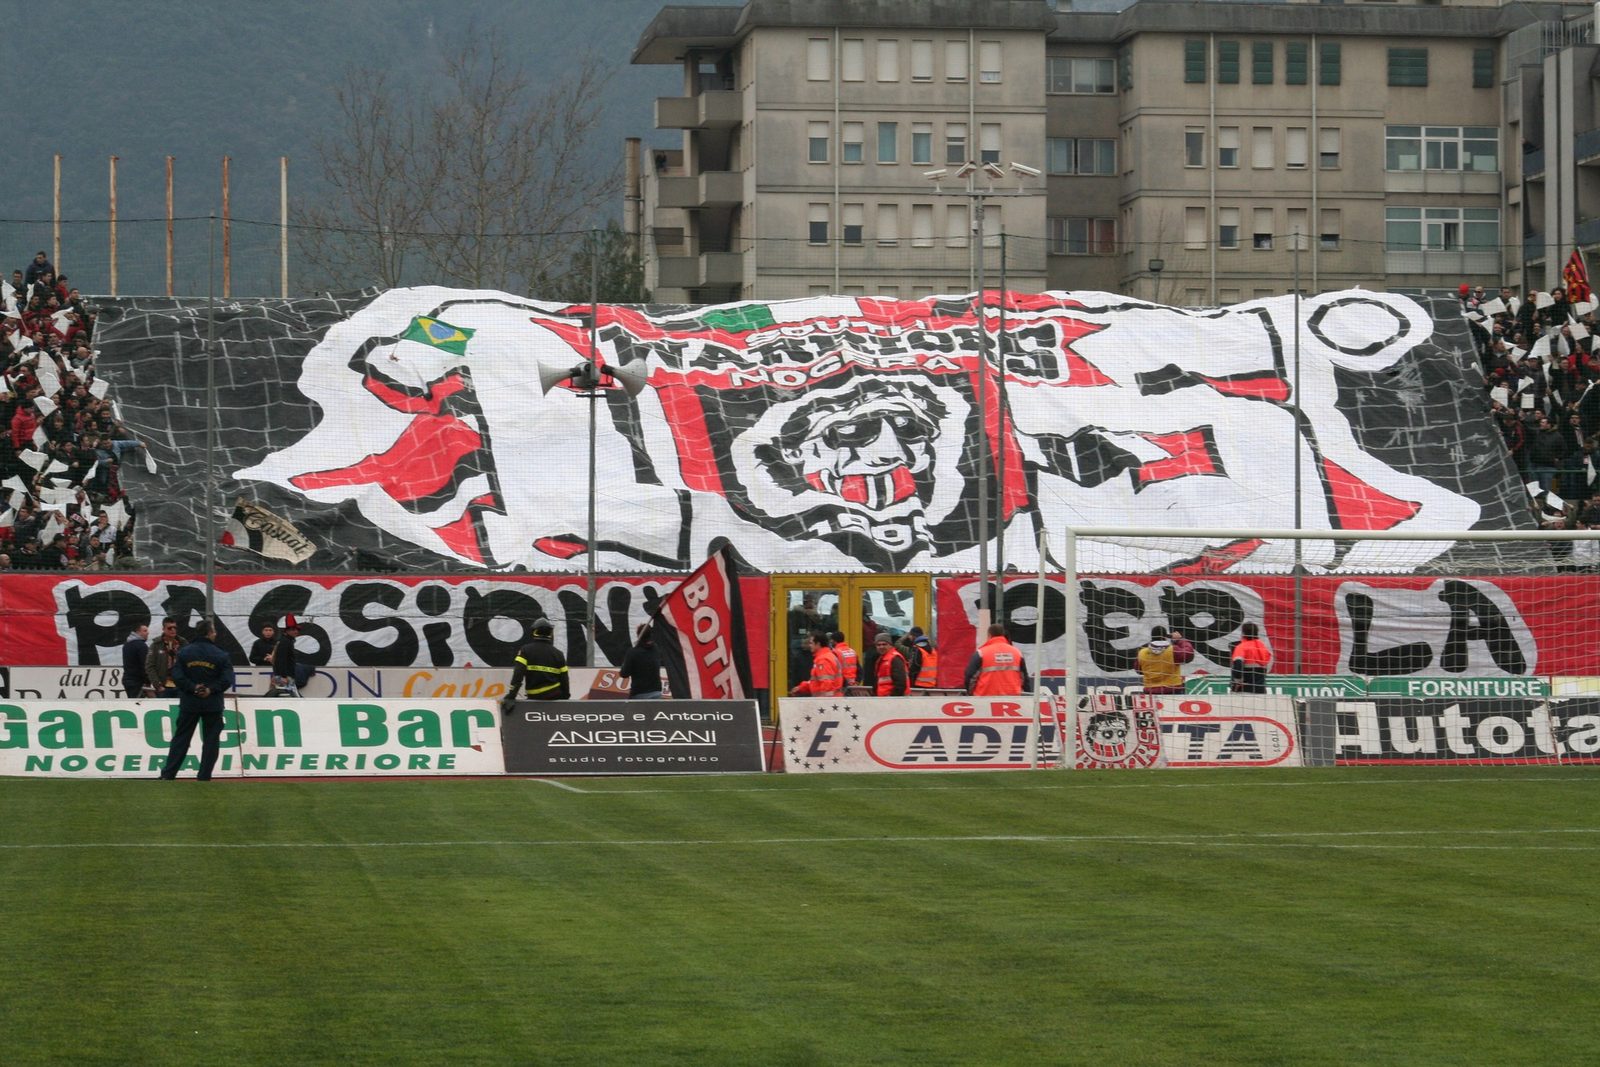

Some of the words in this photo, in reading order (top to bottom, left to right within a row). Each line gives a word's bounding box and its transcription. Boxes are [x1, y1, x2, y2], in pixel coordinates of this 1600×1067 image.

[745, 315, 928, 346] SOUTH
[598, 322, 1062, 381] WARRIORS
[731, 349, 963, 386] NOCERA
[975, 580, 1245, 672] PER
[1345, 579, 1526, 675] LA
[59, 669, 90, 687] dal
[98, 669, 124, 687] 18
[1408, 680, 1542, 696] FORNITURE
[525, 711, 625, 723] Giuseppe
[633, 713, 646, 722] e
[653, 711, 734, 722] Antonio
[941, 701, 1212, 716] GRO
[0, 704, 304, 749] Garden
[337, 703, 496, 749] Bar
[548, 730, 717, 744] ANGRISANI
[806, 721, 840, 758] E
[1336, 700, 1600, 755] Autota
[902, 724, 1264, 761] ADILTA
[25, 754, 202, 772] NOCERA
[221, 753, 457, 772] INFERIORE
[617, 755, 720, 764] fotografico
